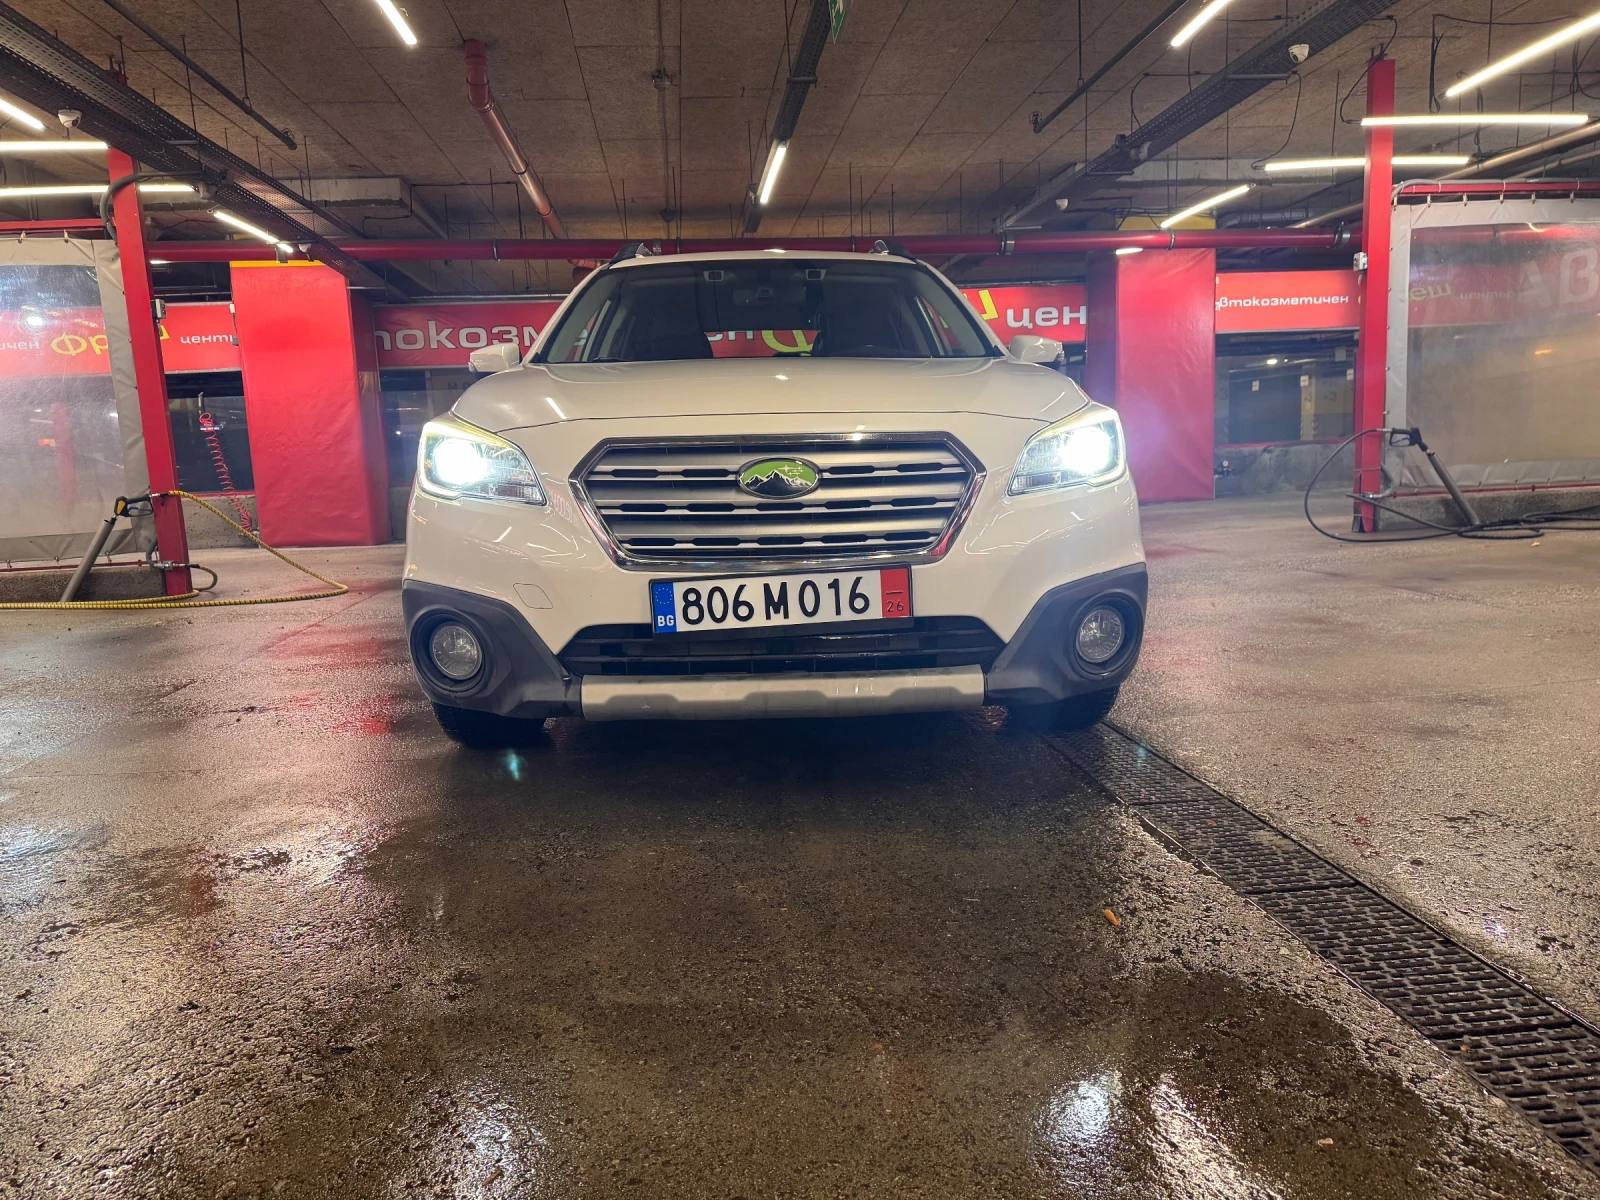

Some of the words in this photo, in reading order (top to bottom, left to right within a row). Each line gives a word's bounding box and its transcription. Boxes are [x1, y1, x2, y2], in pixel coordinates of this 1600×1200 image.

[180, 334, 234, 344] цент
[682, 584, 755, 625] 806
[763, 581, 789, 620] M
[798, 576, 870, 618] 016
[886, 599, 904, 613] 26
[657, 614, 674, 627] BG
